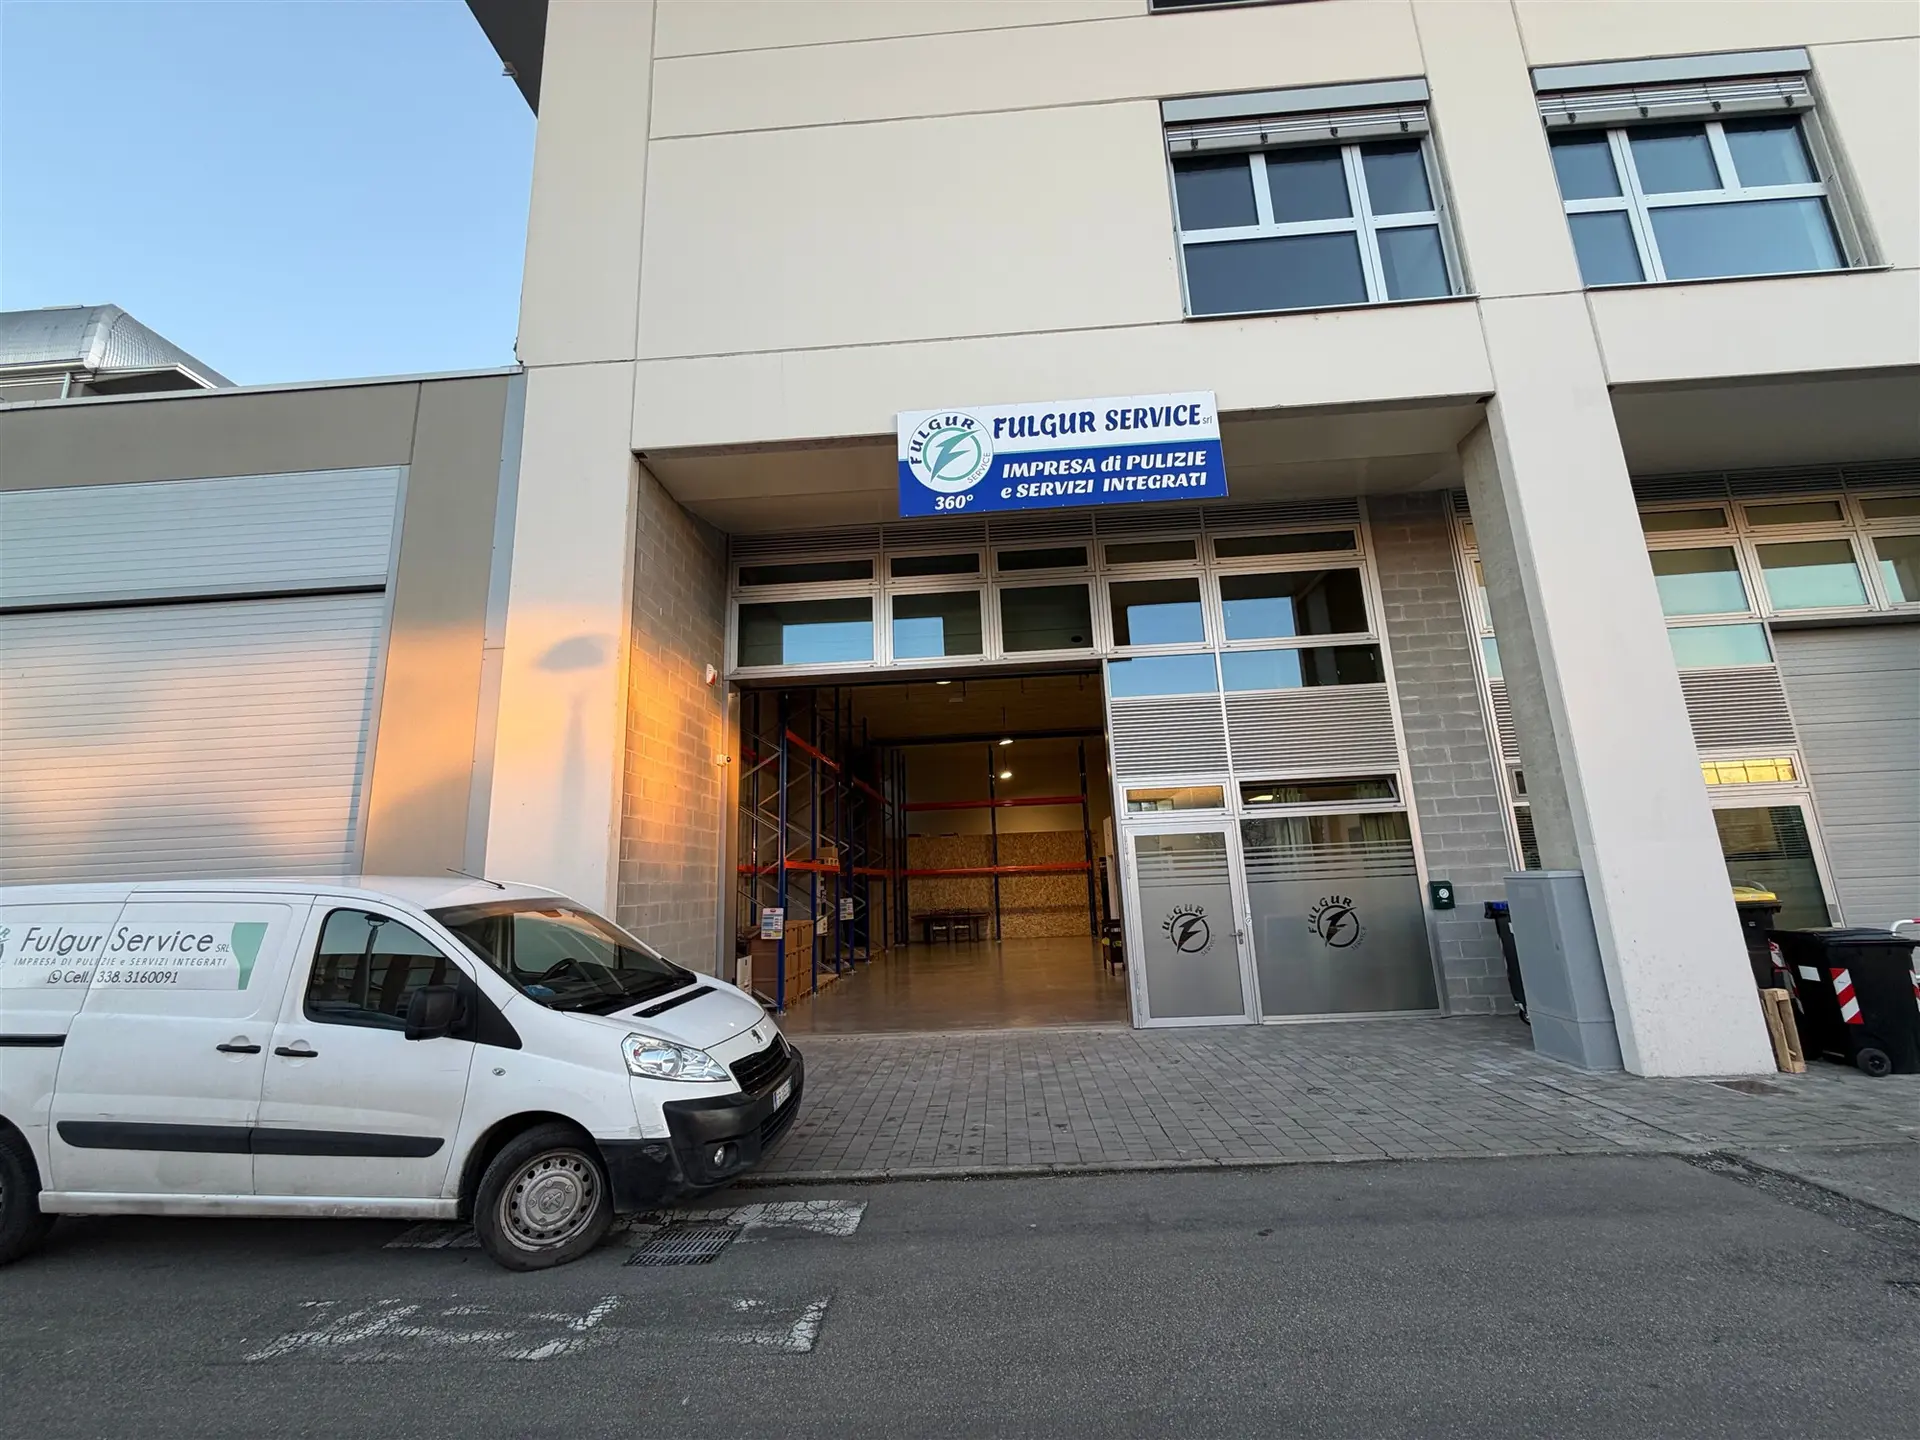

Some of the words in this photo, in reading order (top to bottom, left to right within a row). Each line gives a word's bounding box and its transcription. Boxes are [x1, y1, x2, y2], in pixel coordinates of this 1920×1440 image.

[993, 411, 1096, 439] FULGUR
[1105, 404, 1201, 431] SERVICE
[1202, 416, 1212, 424] srl
[910, 416, 975, 465] FULGUR
[967, 452, 991, 484] SERVICE
[1002, 458, 1096, 479] IMPRESA
[1100, 455, 1122, 472] di
[1126, 450, 1207, 471] PULIZIE
[1000, 487, 1012, 499] e
[1016, 479, 1094, 498] SERVIZI
[1103, 472, 1207, 492] INTEGRATI
[934, 494, 974, 510] 360°
[1308, 895, 1352, 933] FULGUR
[20, 927, 103, 956] Fulgur
[110, 926, 214, 952] Service
[215, 944, 230, 953] SRL
[14, 957, 56, 966] IMPRESA
[61, 957, 71, 966] DI
[76, 957, 117, 966] PULIZIE
[129, 957, 169, 966] SERVIZI
[172, 957, 227, 967] INTEGRATI
[64, 970, 90, 984] Cell.
[97, 970, 121, 984] 338.
[124, 970, 178, 984] 3160091
